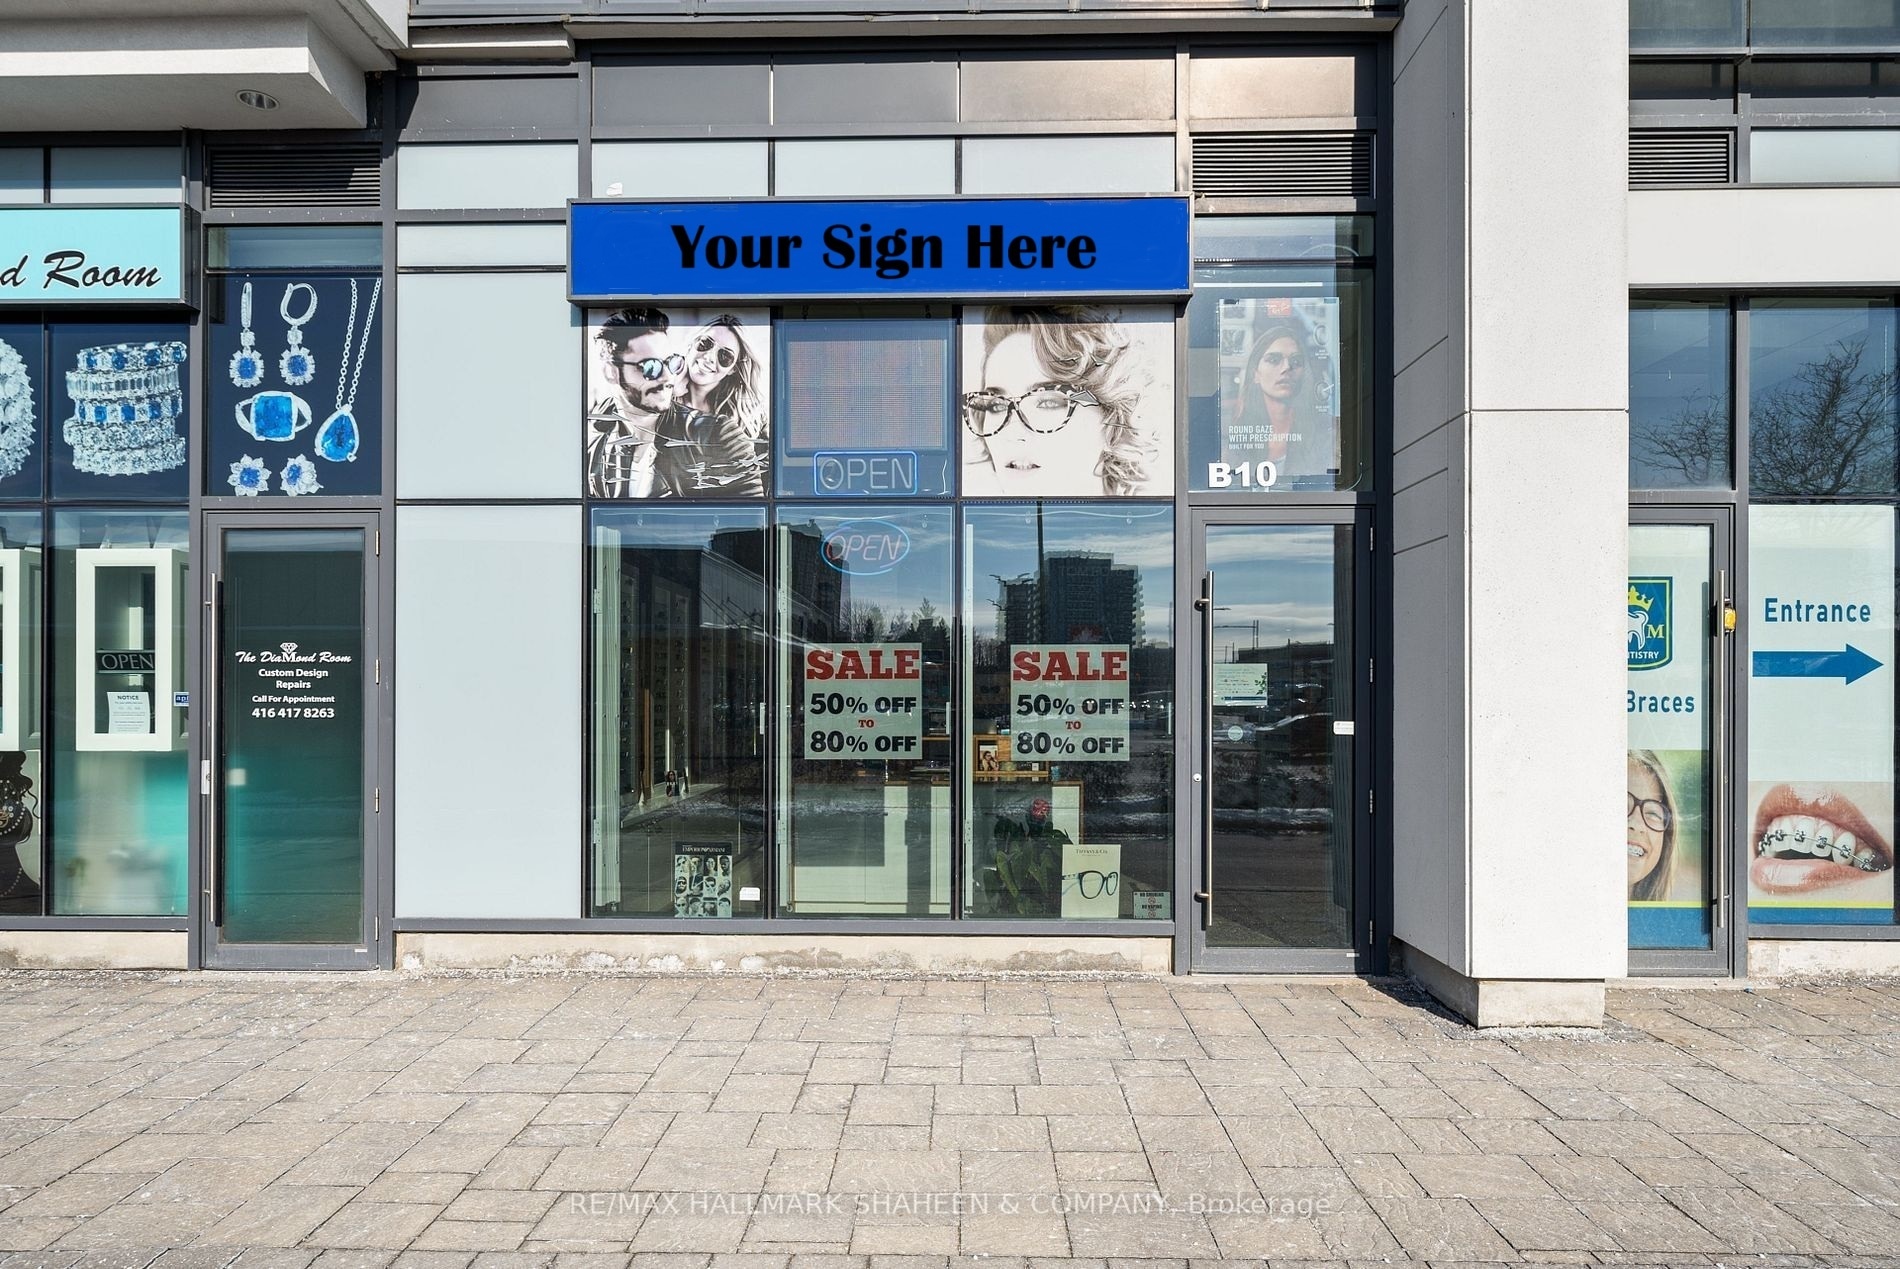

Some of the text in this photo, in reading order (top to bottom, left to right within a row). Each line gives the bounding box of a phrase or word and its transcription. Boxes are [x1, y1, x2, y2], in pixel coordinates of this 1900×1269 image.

[670, 223, 1097, 280] Your Sign Here
[43, 250, 161, 289] Room
[1228, 425, 1274, 434] ROUND GAZE
[1229, 433, 1302, 442] WITH PRESCRIPTION
[820, 458, 912, 490] OPEN
[1208, 461, 1277, 488] B10
[826, 534, 901, 561] OPEN
[1764, 597, 1872, 623] Entrance
[1646, 624, 1665, 639] M
[101, 654, 154, 669] OPEN
[235, 651, 257, 663] The
[319, 651, 353, 663] Room
[806, 650, 921, 680] SALE
[1012, 651, 1128, 681] SALE
[258, 668, 329, 679] Custom Design
[276, 680, 312, 690] Repairs
[252, 695, 336, 704] Call For Appointment
[810, 693, 917, 715] 50% OFF
[1016, 694, 1125, 716] 50% OFF
[1628, 690, 1695, 713] Braces
[251, 708, 335, 718] 416 417 8263
[858, 719, 875, 729] TO
[1065, 720, 1082, 730] TO
[810, 731, 917, 753] 80% OFF
[1016, 732, 1125, 754] 80% OFF
